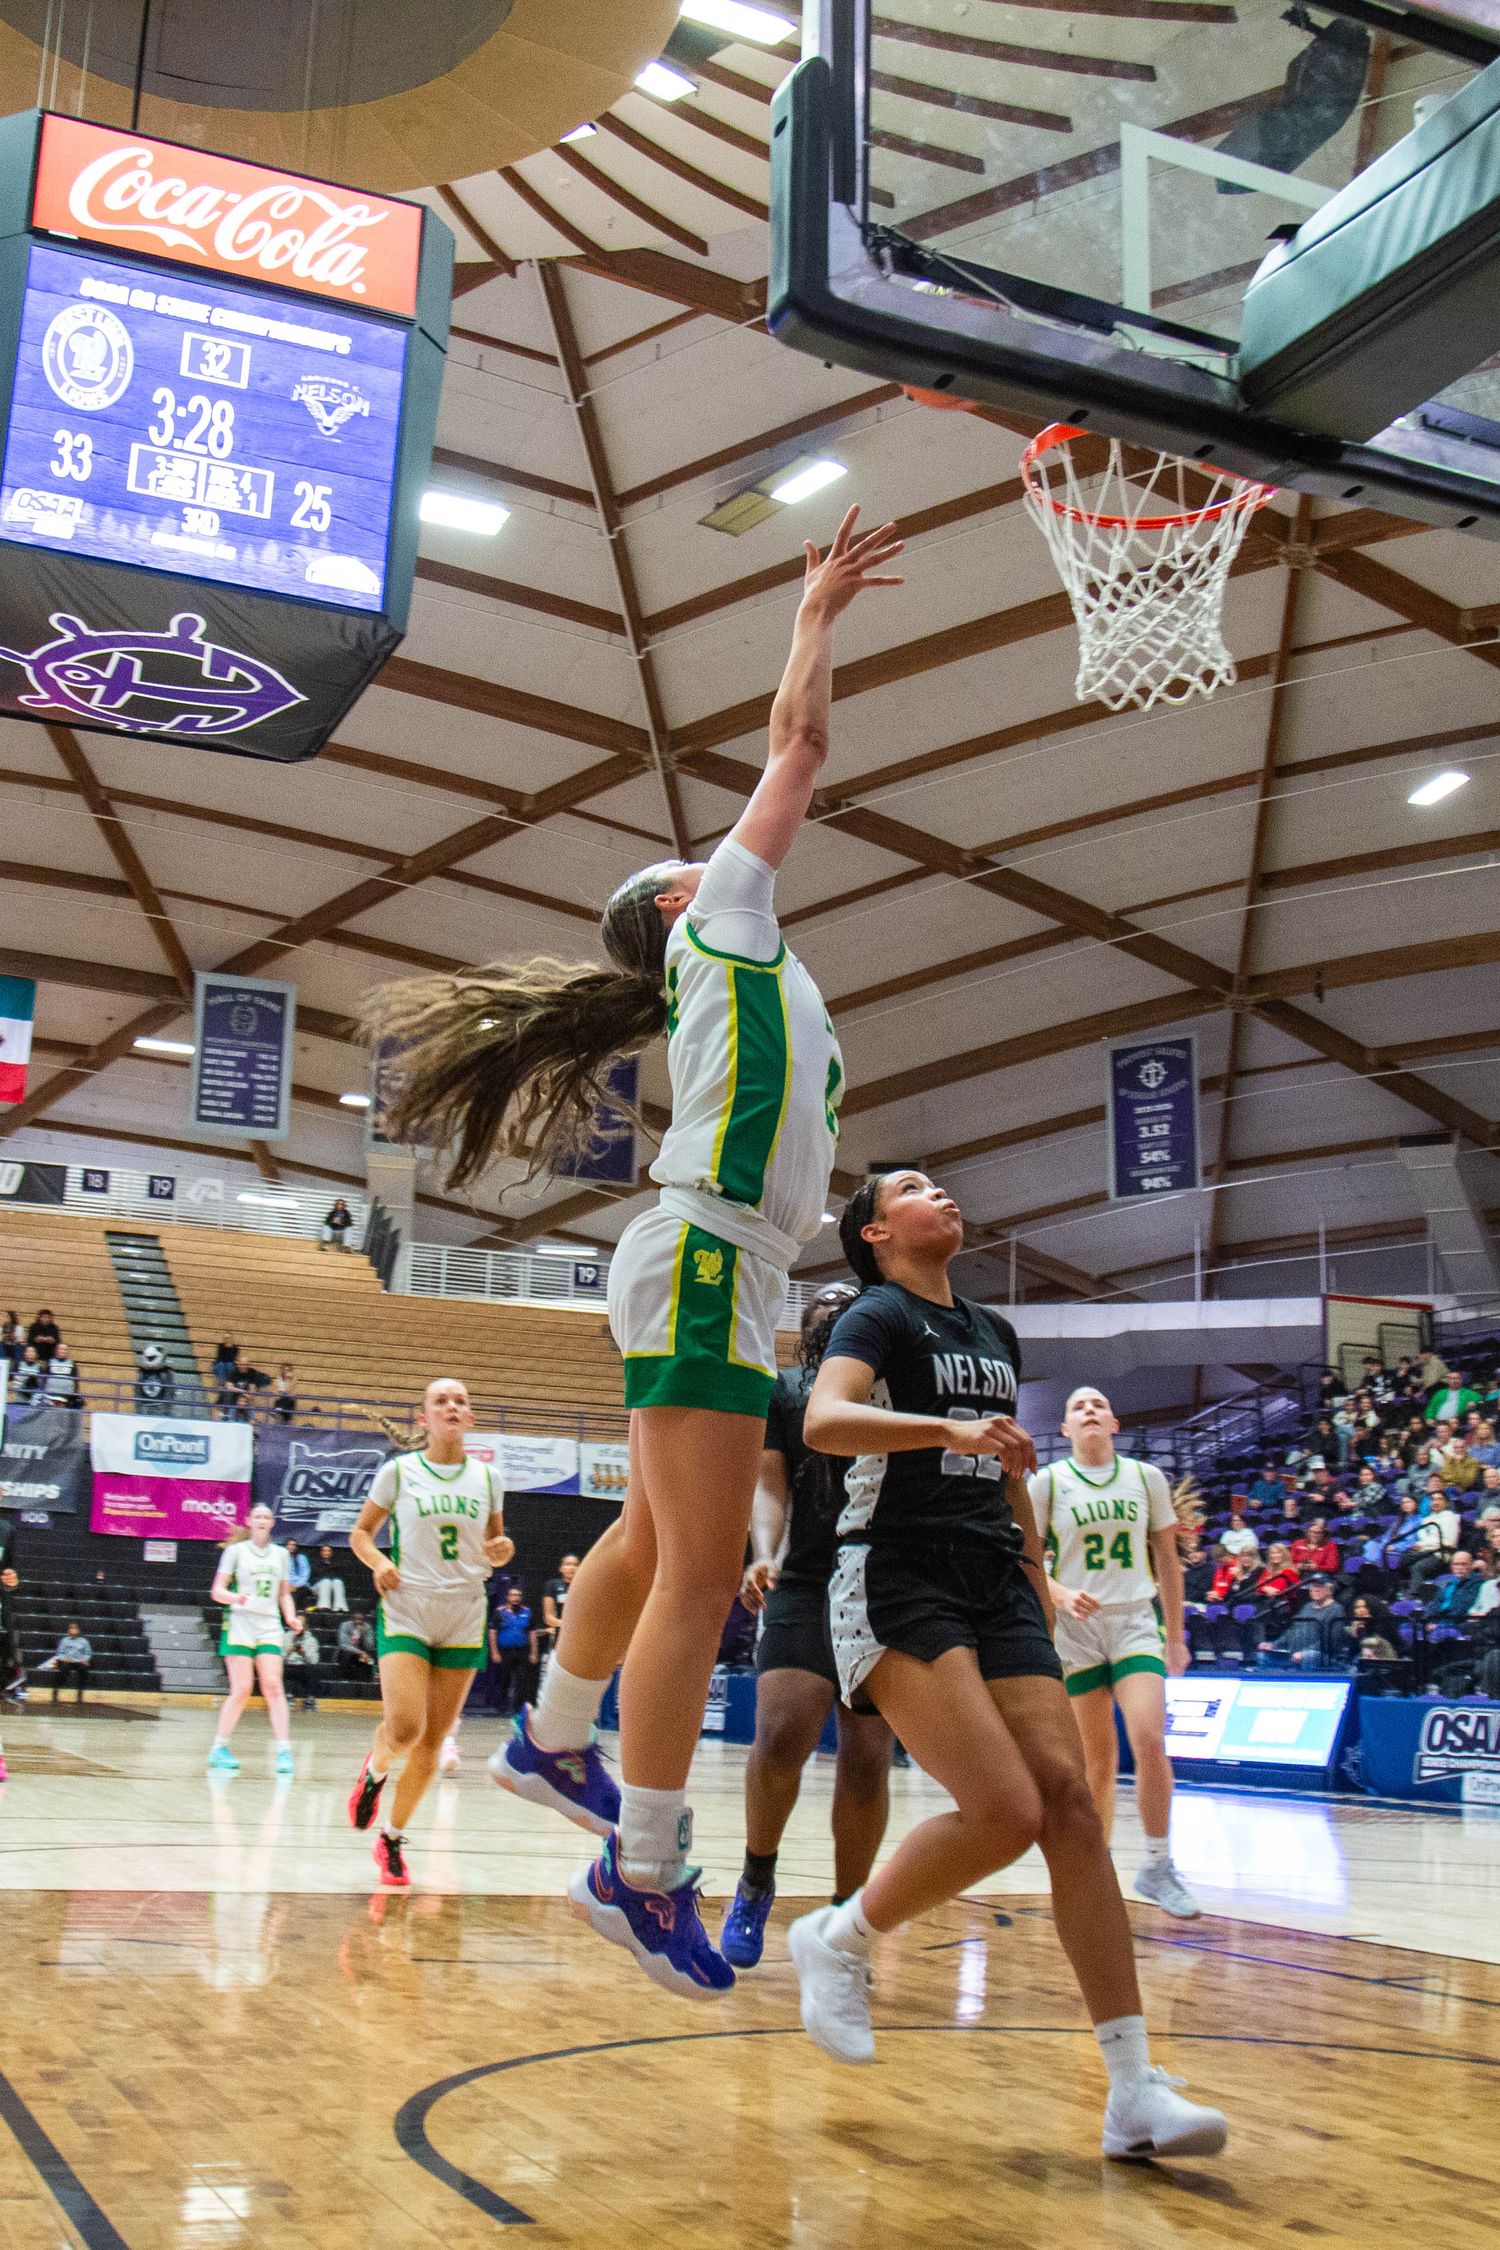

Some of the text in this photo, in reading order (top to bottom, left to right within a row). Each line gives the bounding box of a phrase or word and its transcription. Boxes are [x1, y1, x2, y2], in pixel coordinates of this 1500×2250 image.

[69, 147, 390, 287] Coca-Cola
[199, 341, 232, 380] 32
[291, 383, 370, 417] NELSON
[148, 387, 235, 459] 3:28
[50, 429, 93, 482] 33
[290, 481, 333, 532] 25
[86, 1173, 104, 1188] 18
[152, 1179, 173, 1196] 19
[578, 1266, 597, 1283] 19
[415, 1494, 479, 1519] LIONS
[1071, 1499, 1137, 1526] LIONS
[439, 1524, 459, 1561] 2
[1083, 1530, 1133, 1570] 24
